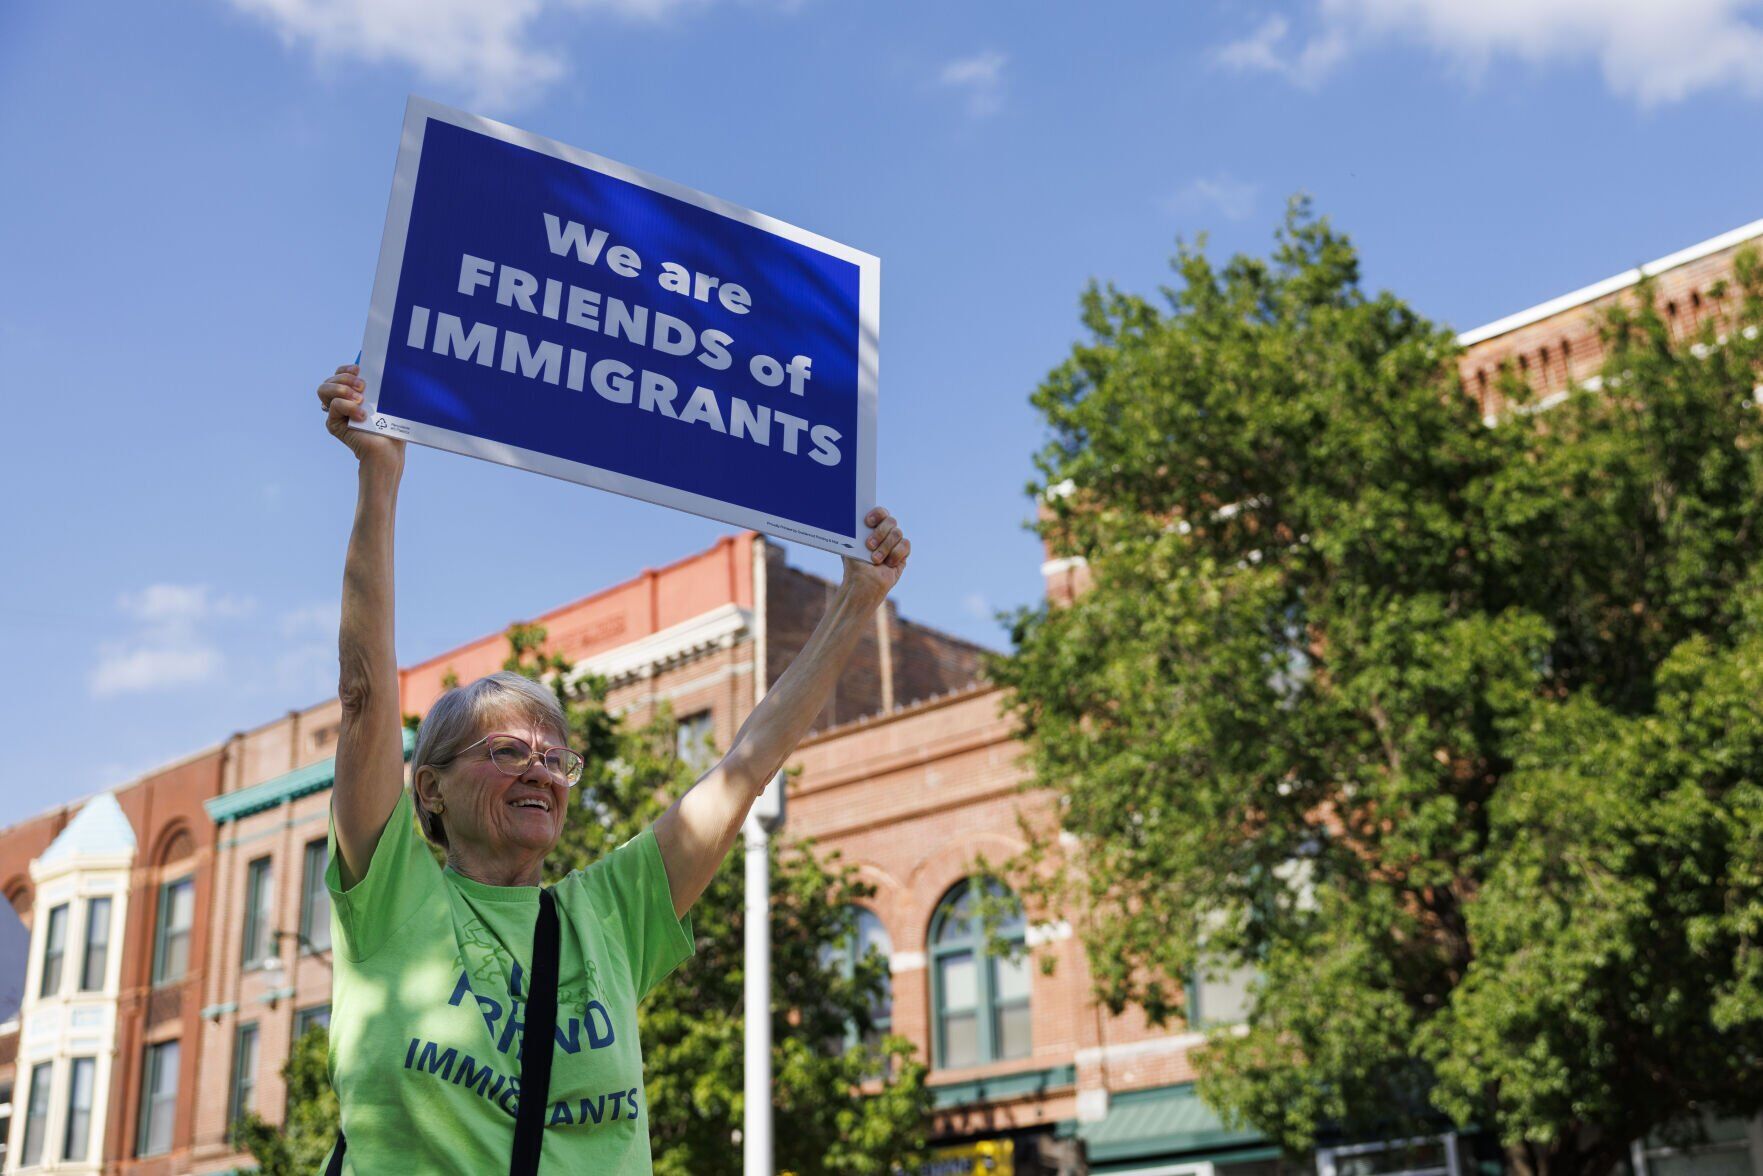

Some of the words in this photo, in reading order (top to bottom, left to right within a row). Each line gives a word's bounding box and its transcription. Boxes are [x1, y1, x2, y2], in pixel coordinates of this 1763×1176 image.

[543, 212, 641, 278] We
[657, 261, 752, 315] are
[457, 253, 735, 371] FRIENDS
[749, 355, 812, 397] of
[406, 304, 842, 467] IMMIGRANTS
[447, 969, 616, 1060] RIND
[404, 1037, 640, 1126] IMMIGANTS
